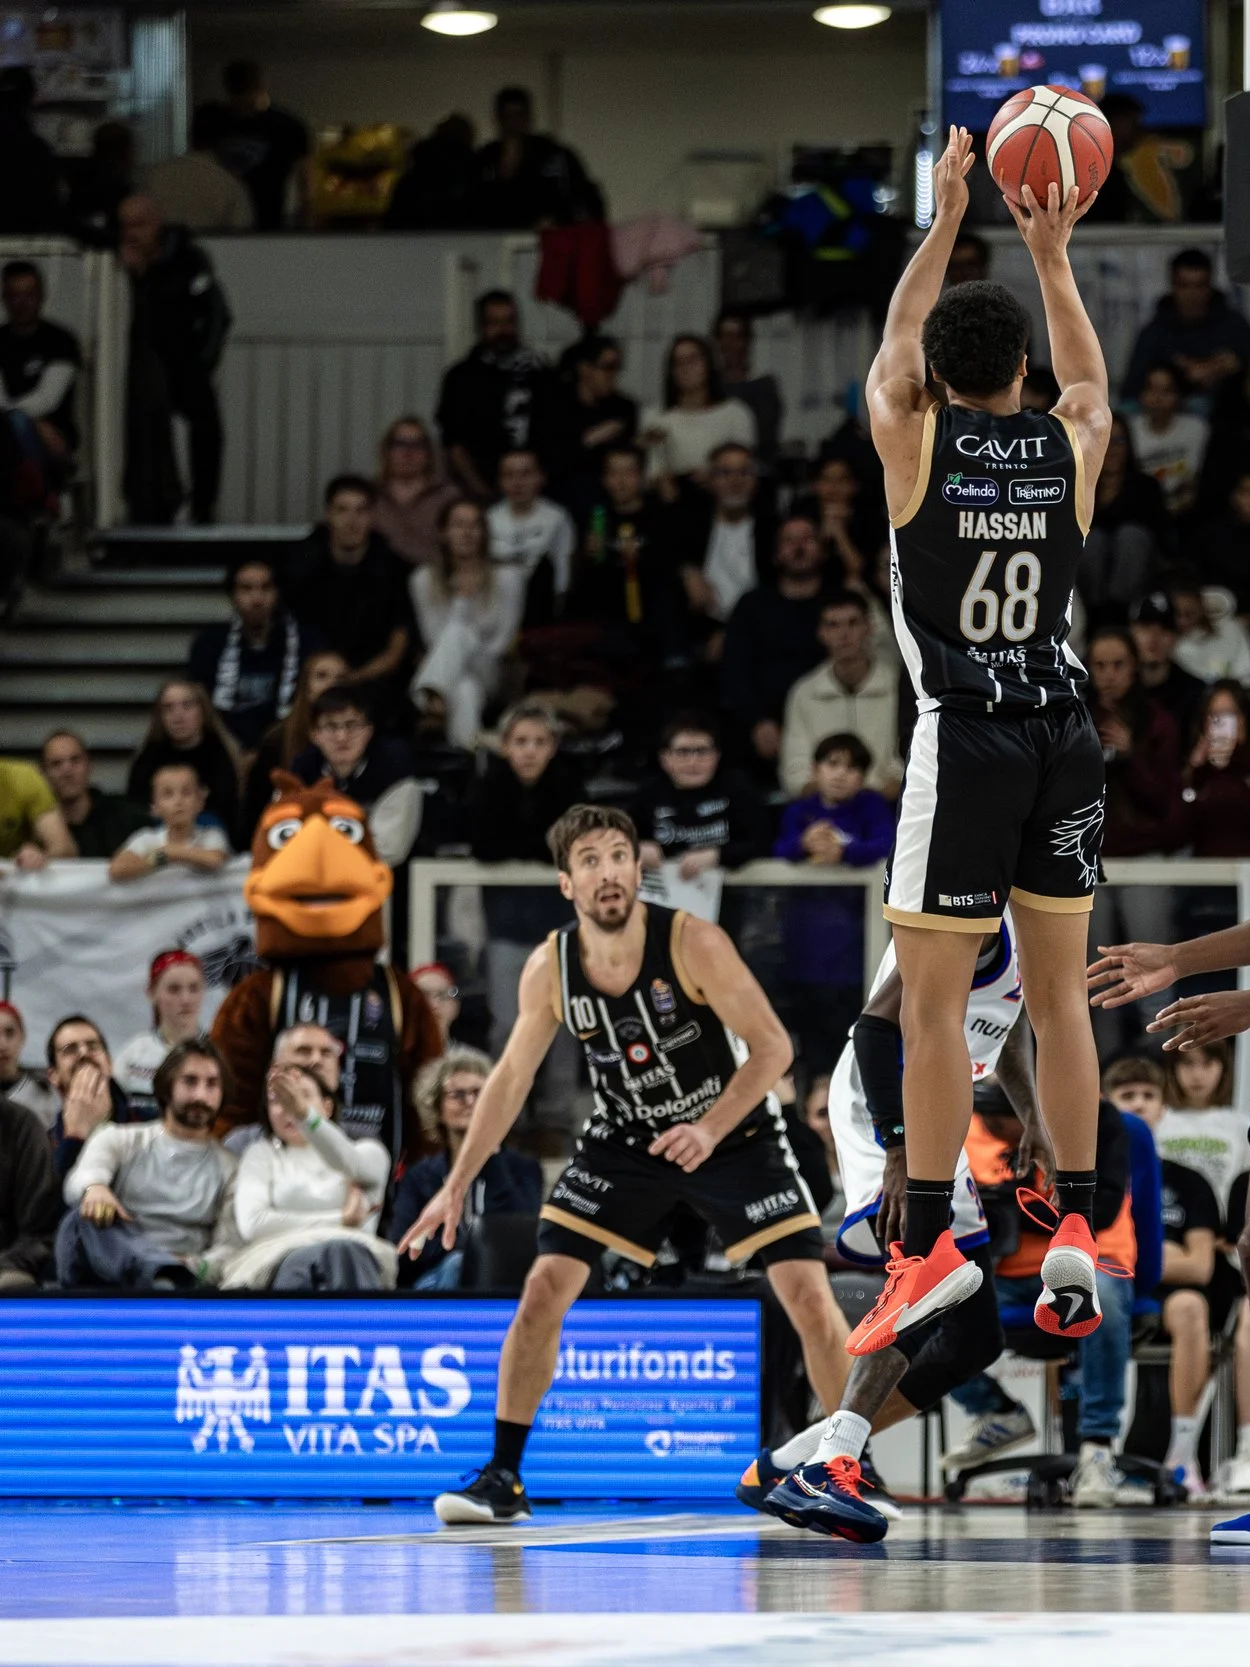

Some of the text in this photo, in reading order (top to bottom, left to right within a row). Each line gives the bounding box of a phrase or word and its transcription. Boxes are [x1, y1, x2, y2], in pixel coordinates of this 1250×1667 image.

[956, 434, 1048, 460] CAVIT
[985, 462, 1028, 470] TRENTO
[946, 483, 996, 497] Melinda
[1015, 486, 1060, 499] TRENTINO
[958, 511, 1047, 540] HASSAN
[959, 551, 1041, 643] 68
[952, 894, 974, 906] BTS
[570, 995, 598, 1031] 10
[970, 1017, 1010, 1040] nut
[635, 1074, 722, 1120] Dolomiti
[763, 1188, 799, 1212] ITAS
[283, 1344, 472, 1418] ITAS
[283, 1422, 442, 1456] VITA SPA
